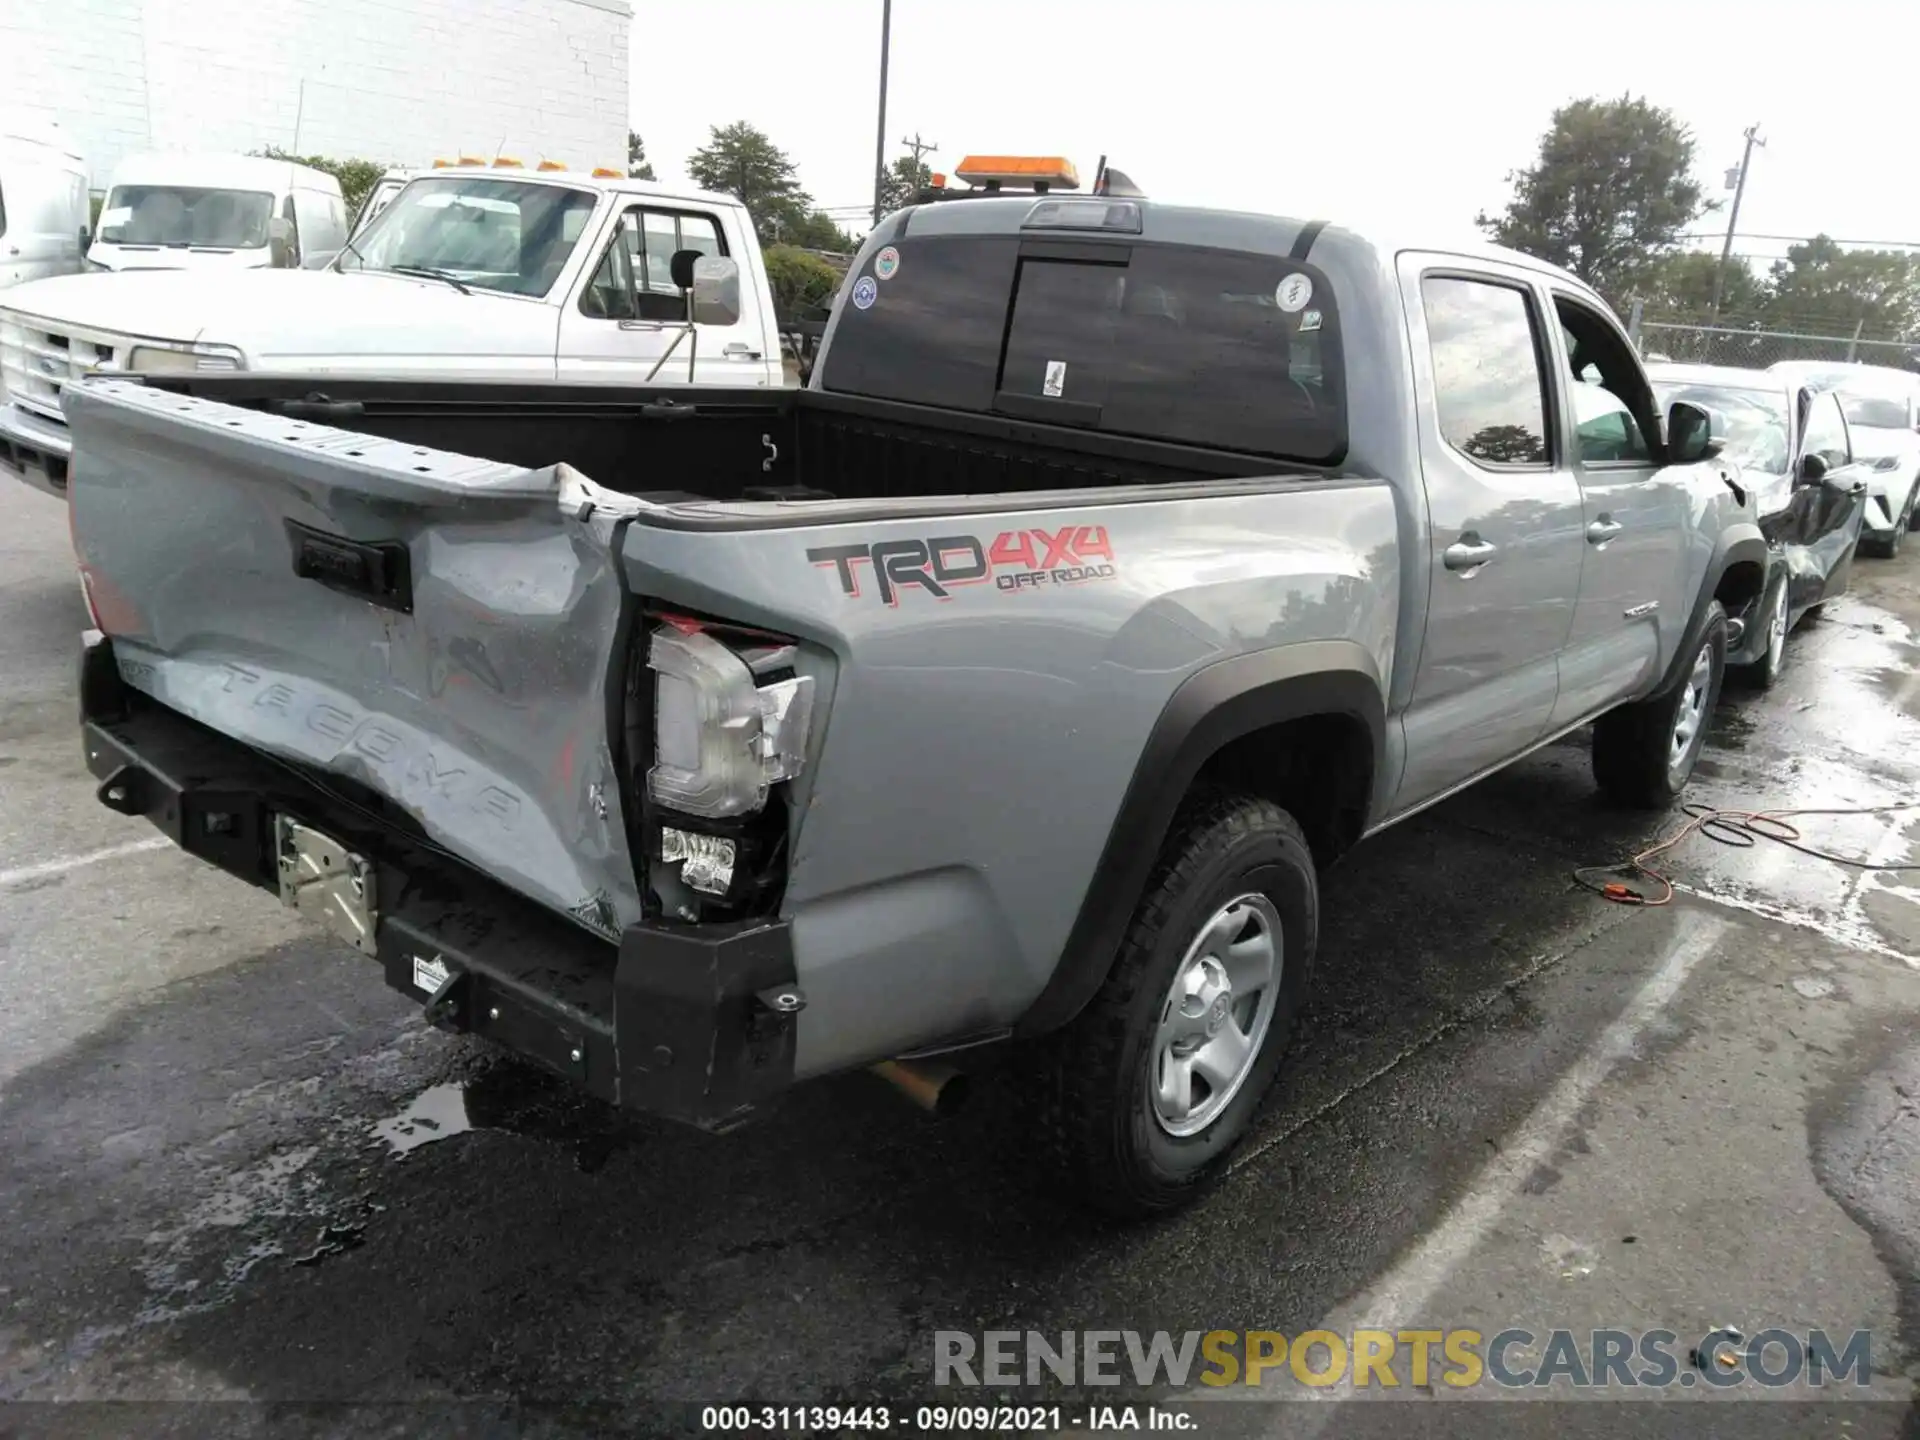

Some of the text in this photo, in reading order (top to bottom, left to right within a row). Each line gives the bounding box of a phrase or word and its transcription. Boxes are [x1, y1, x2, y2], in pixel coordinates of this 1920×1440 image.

[806, 525, 1115, 606] TRD 4X4
[996, 564, 1115, 591] OFF ROAD
